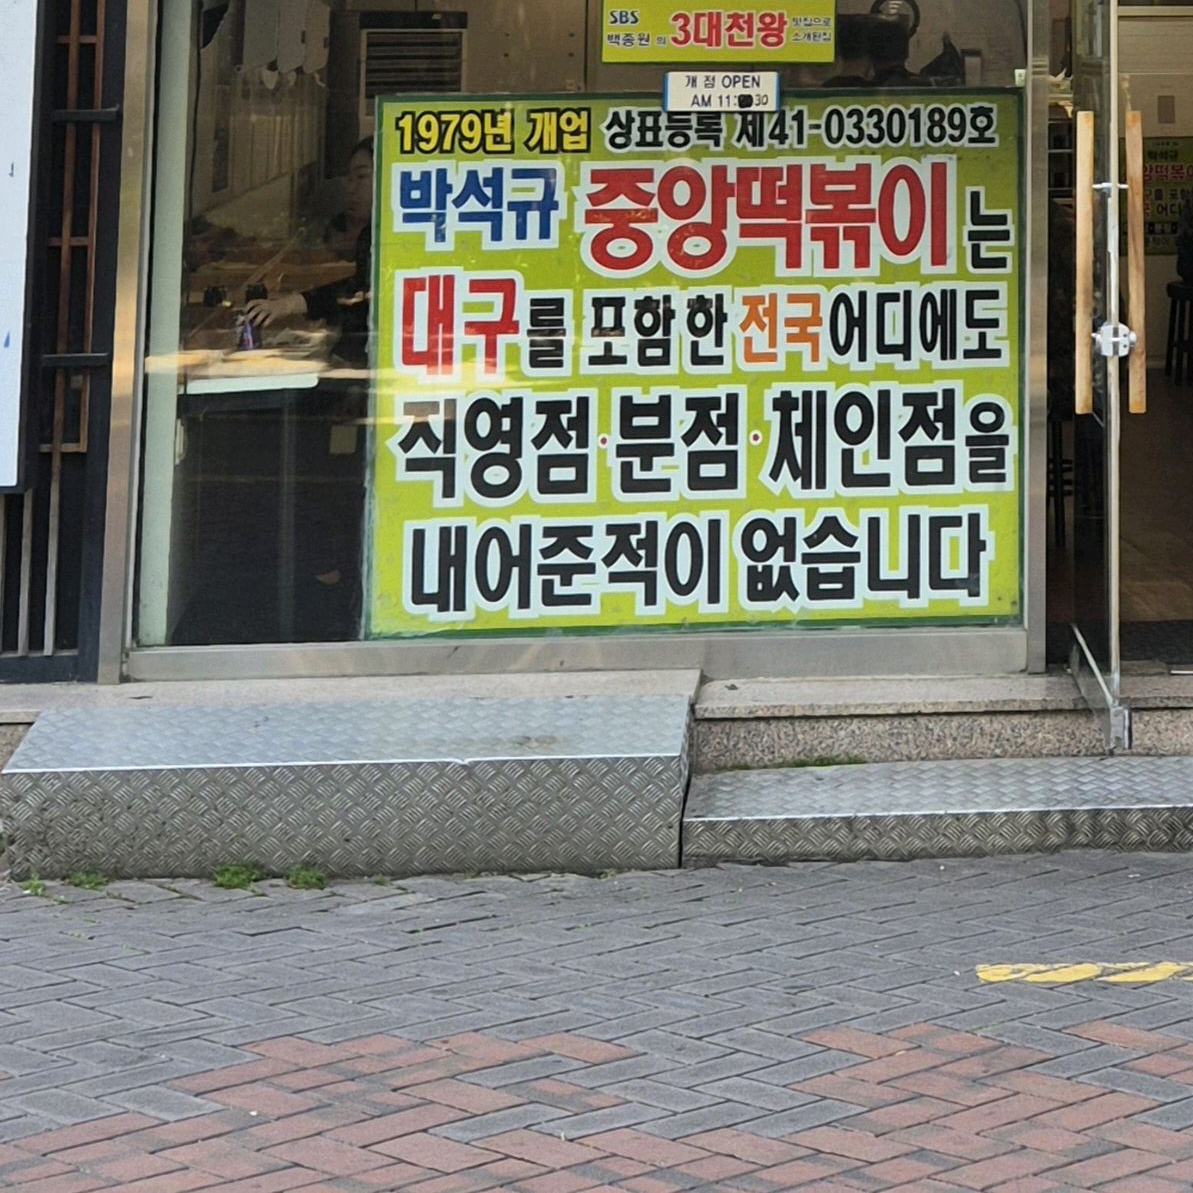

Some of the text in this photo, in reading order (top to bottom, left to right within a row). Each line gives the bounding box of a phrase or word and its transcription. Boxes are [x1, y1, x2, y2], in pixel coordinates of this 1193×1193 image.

[609, 10, 640, 25] SBS
[669, 10, 788, 48] 3대천왕
[691, 94, 712, 107] AM
[722, 75, 761, 88] OPEN
[397, 105, 997, 153] 1979년 개업 상표등록 제41-0330189호
[400, 164, 560, 244] 박석규
[740, 512, 987, 603] 없습니다
